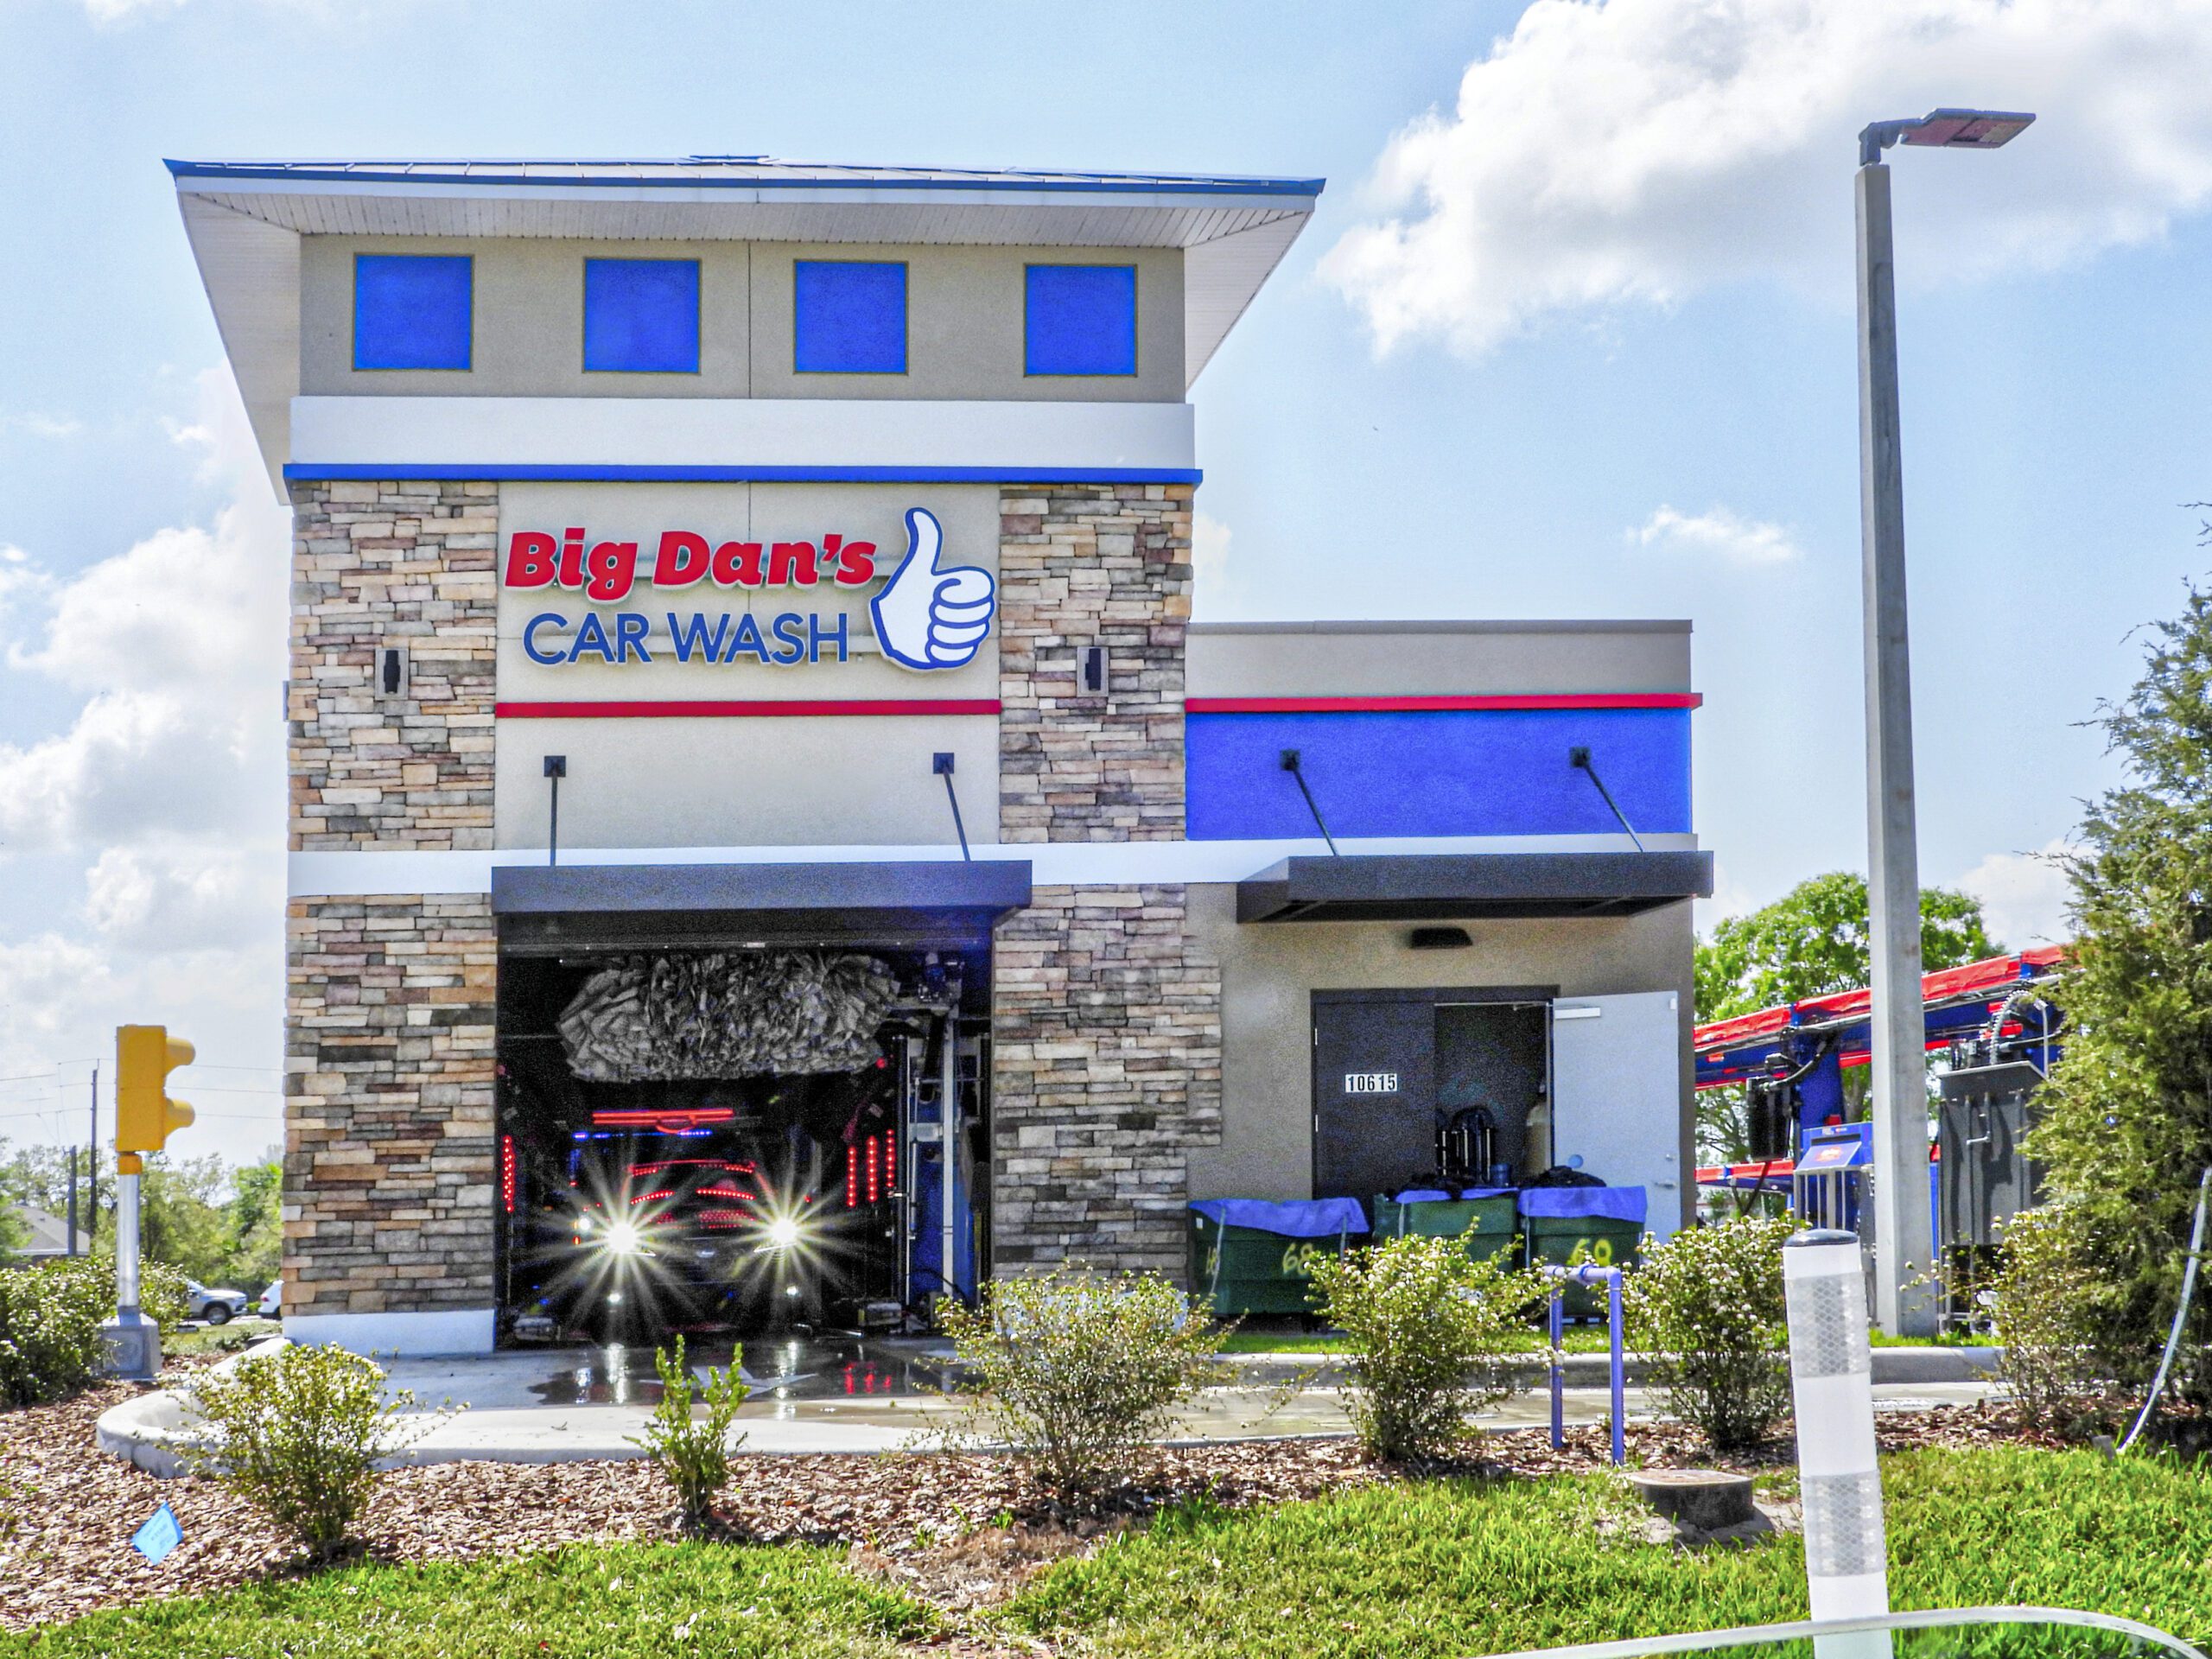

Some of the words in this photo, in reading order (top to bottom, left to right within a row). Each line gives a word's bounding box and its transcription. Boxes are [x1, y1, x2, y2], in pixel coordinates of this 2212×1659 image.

[504, 527, 638, 602] Big
[652, 531, 877, 588] Dan's
[523, 611, 652, 664] CAR
[667, 611, 849, 664] WASH
[1348, 1074, 1395, 1091] 10615
[1282, 1243, 1315, 1275] 68
